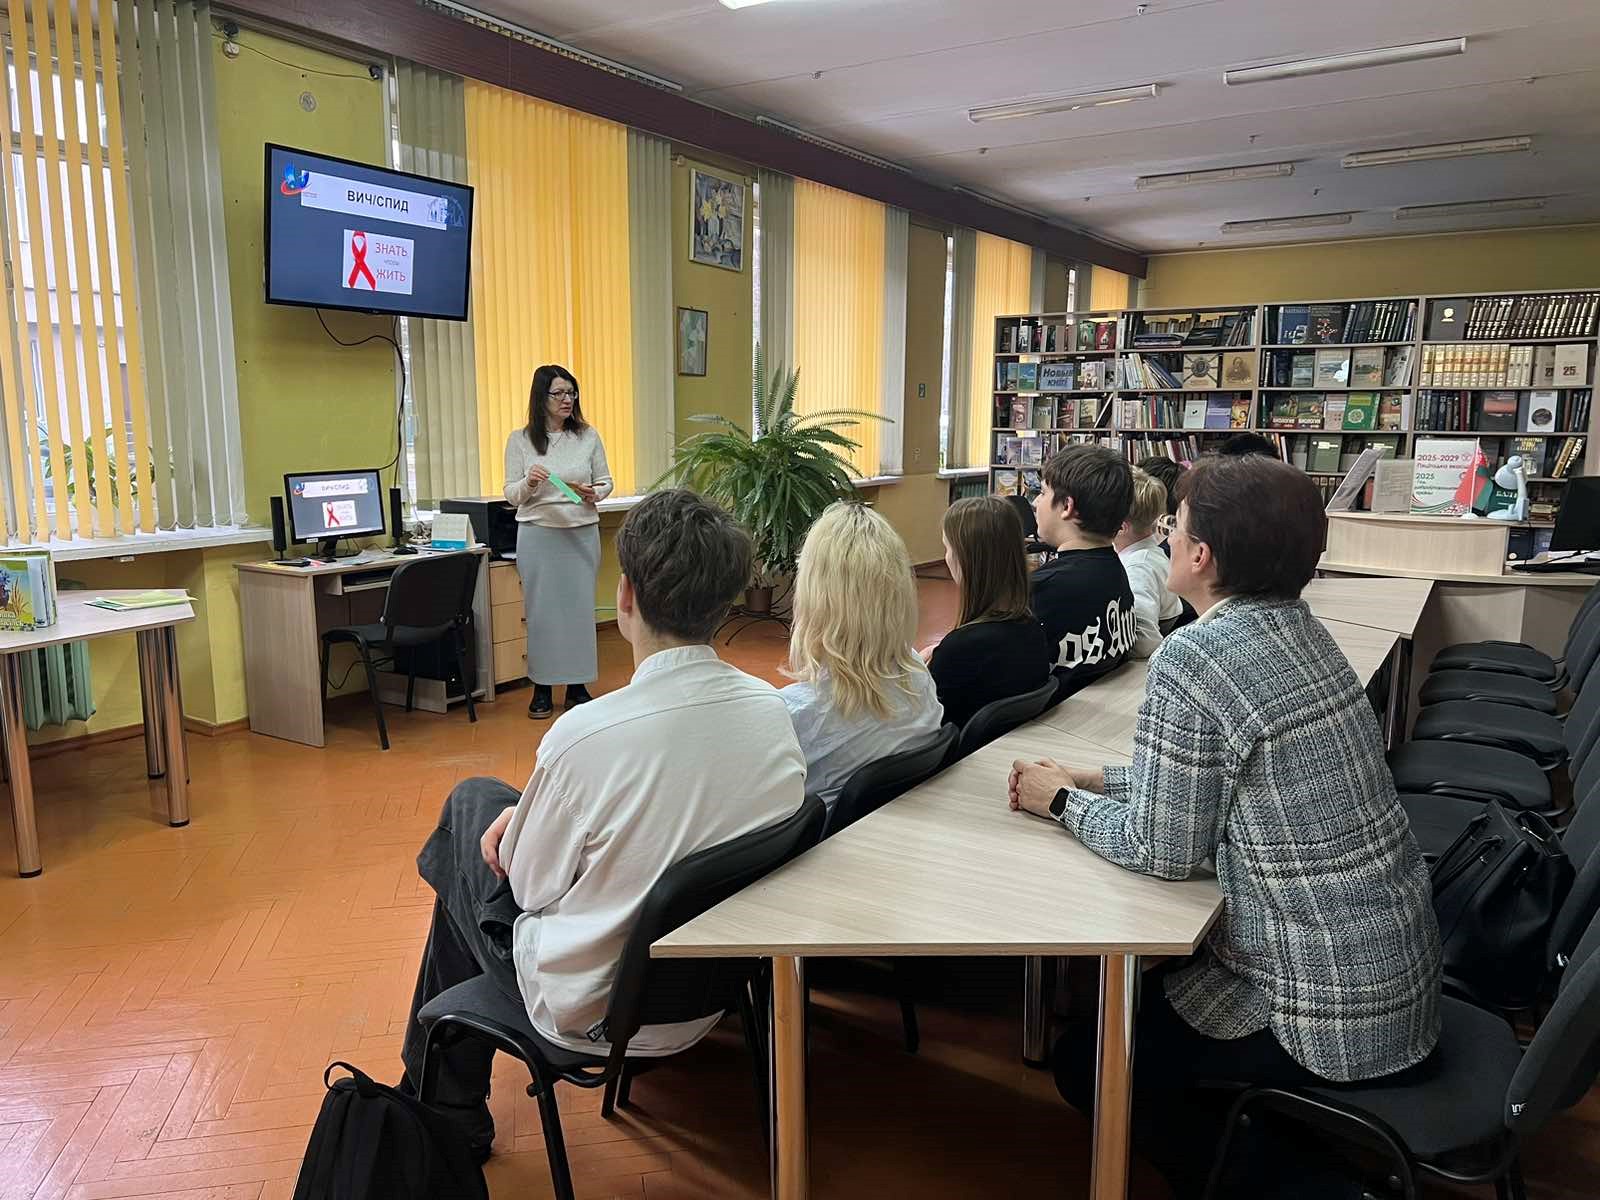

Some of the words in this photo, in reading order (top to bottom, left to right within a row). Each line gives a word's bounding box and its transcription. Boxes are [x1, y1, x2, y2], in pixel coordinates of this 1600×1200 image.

[347, 190, 409, 213] ВИЧ/СПИД
[375, 242, 408, 257] ЗНАТЬ
[376, 268, 407, 282] ЖИТЬ
[1417, 454, 1460, 462] 2025-2029
[1416, 472, 1435, 480] 2025
